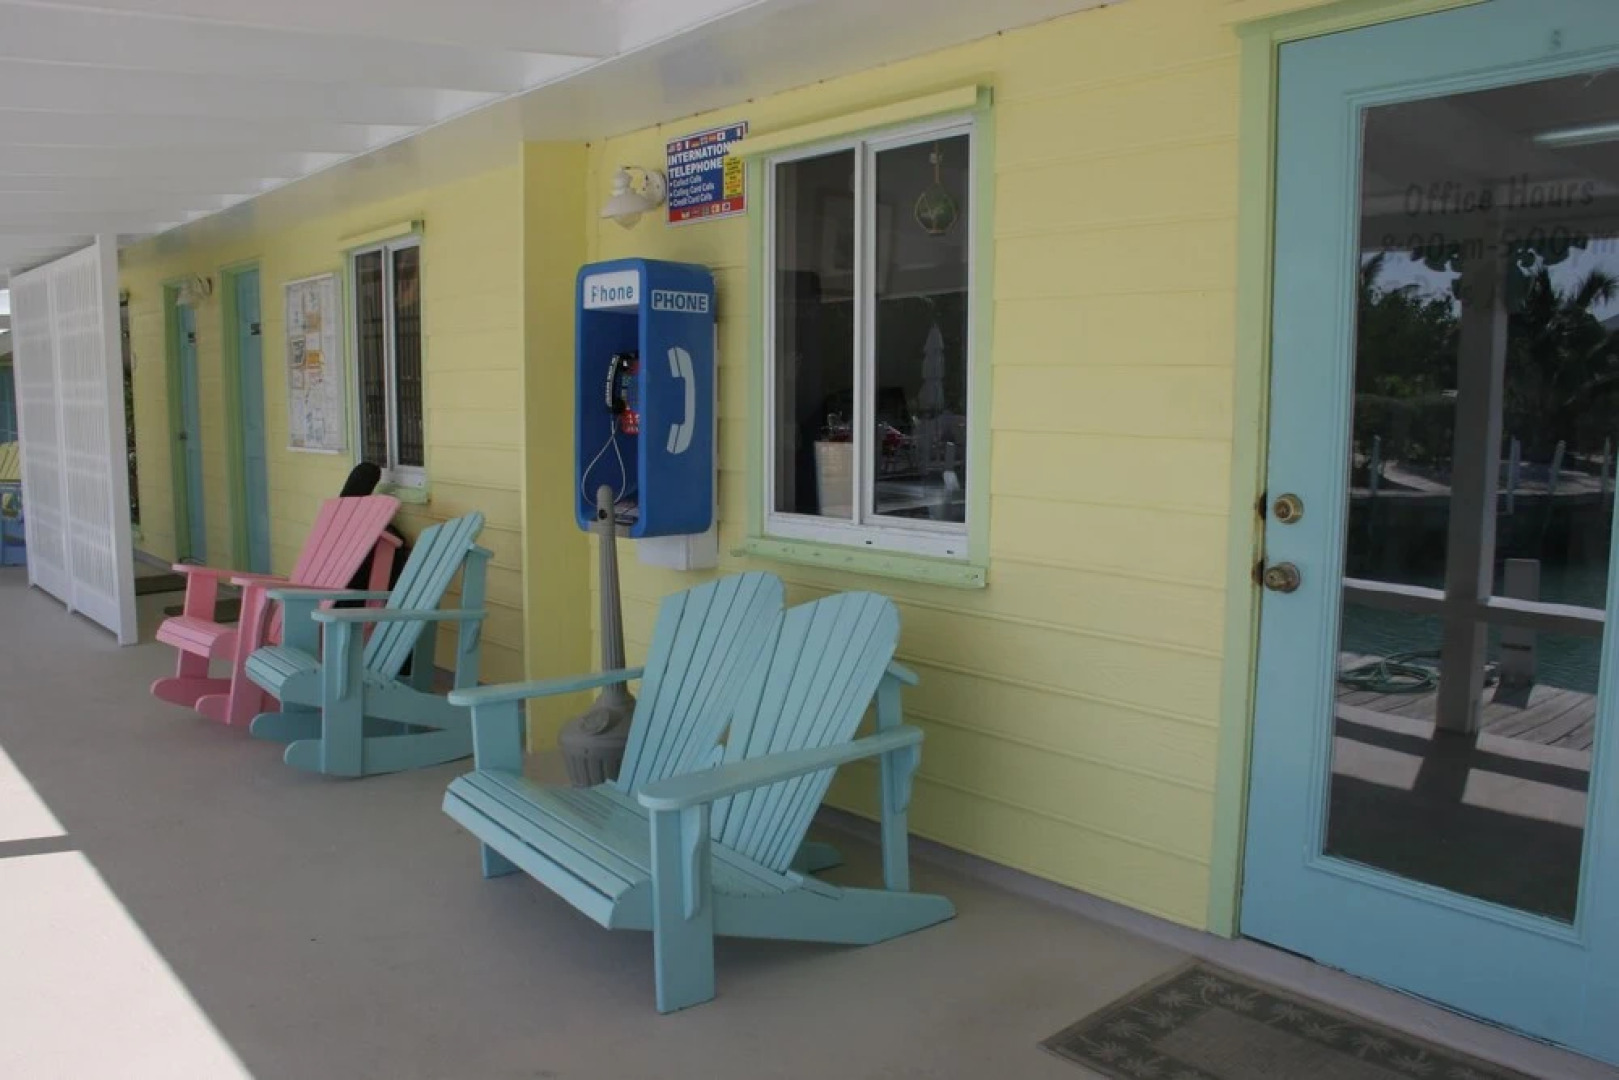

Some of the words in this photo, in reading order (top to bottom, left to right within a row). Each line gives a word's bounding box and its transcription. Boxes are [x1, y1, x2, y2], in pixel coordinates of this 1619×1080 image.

[668, 140, 738, 166] INTERNATION
[668, 157, 723, 179] TELEPHONE
[1404, 181, 1493, 218] Office
[1507, 172, 1595, 212] Hours
[653, 292, 707, 311] PHONE
